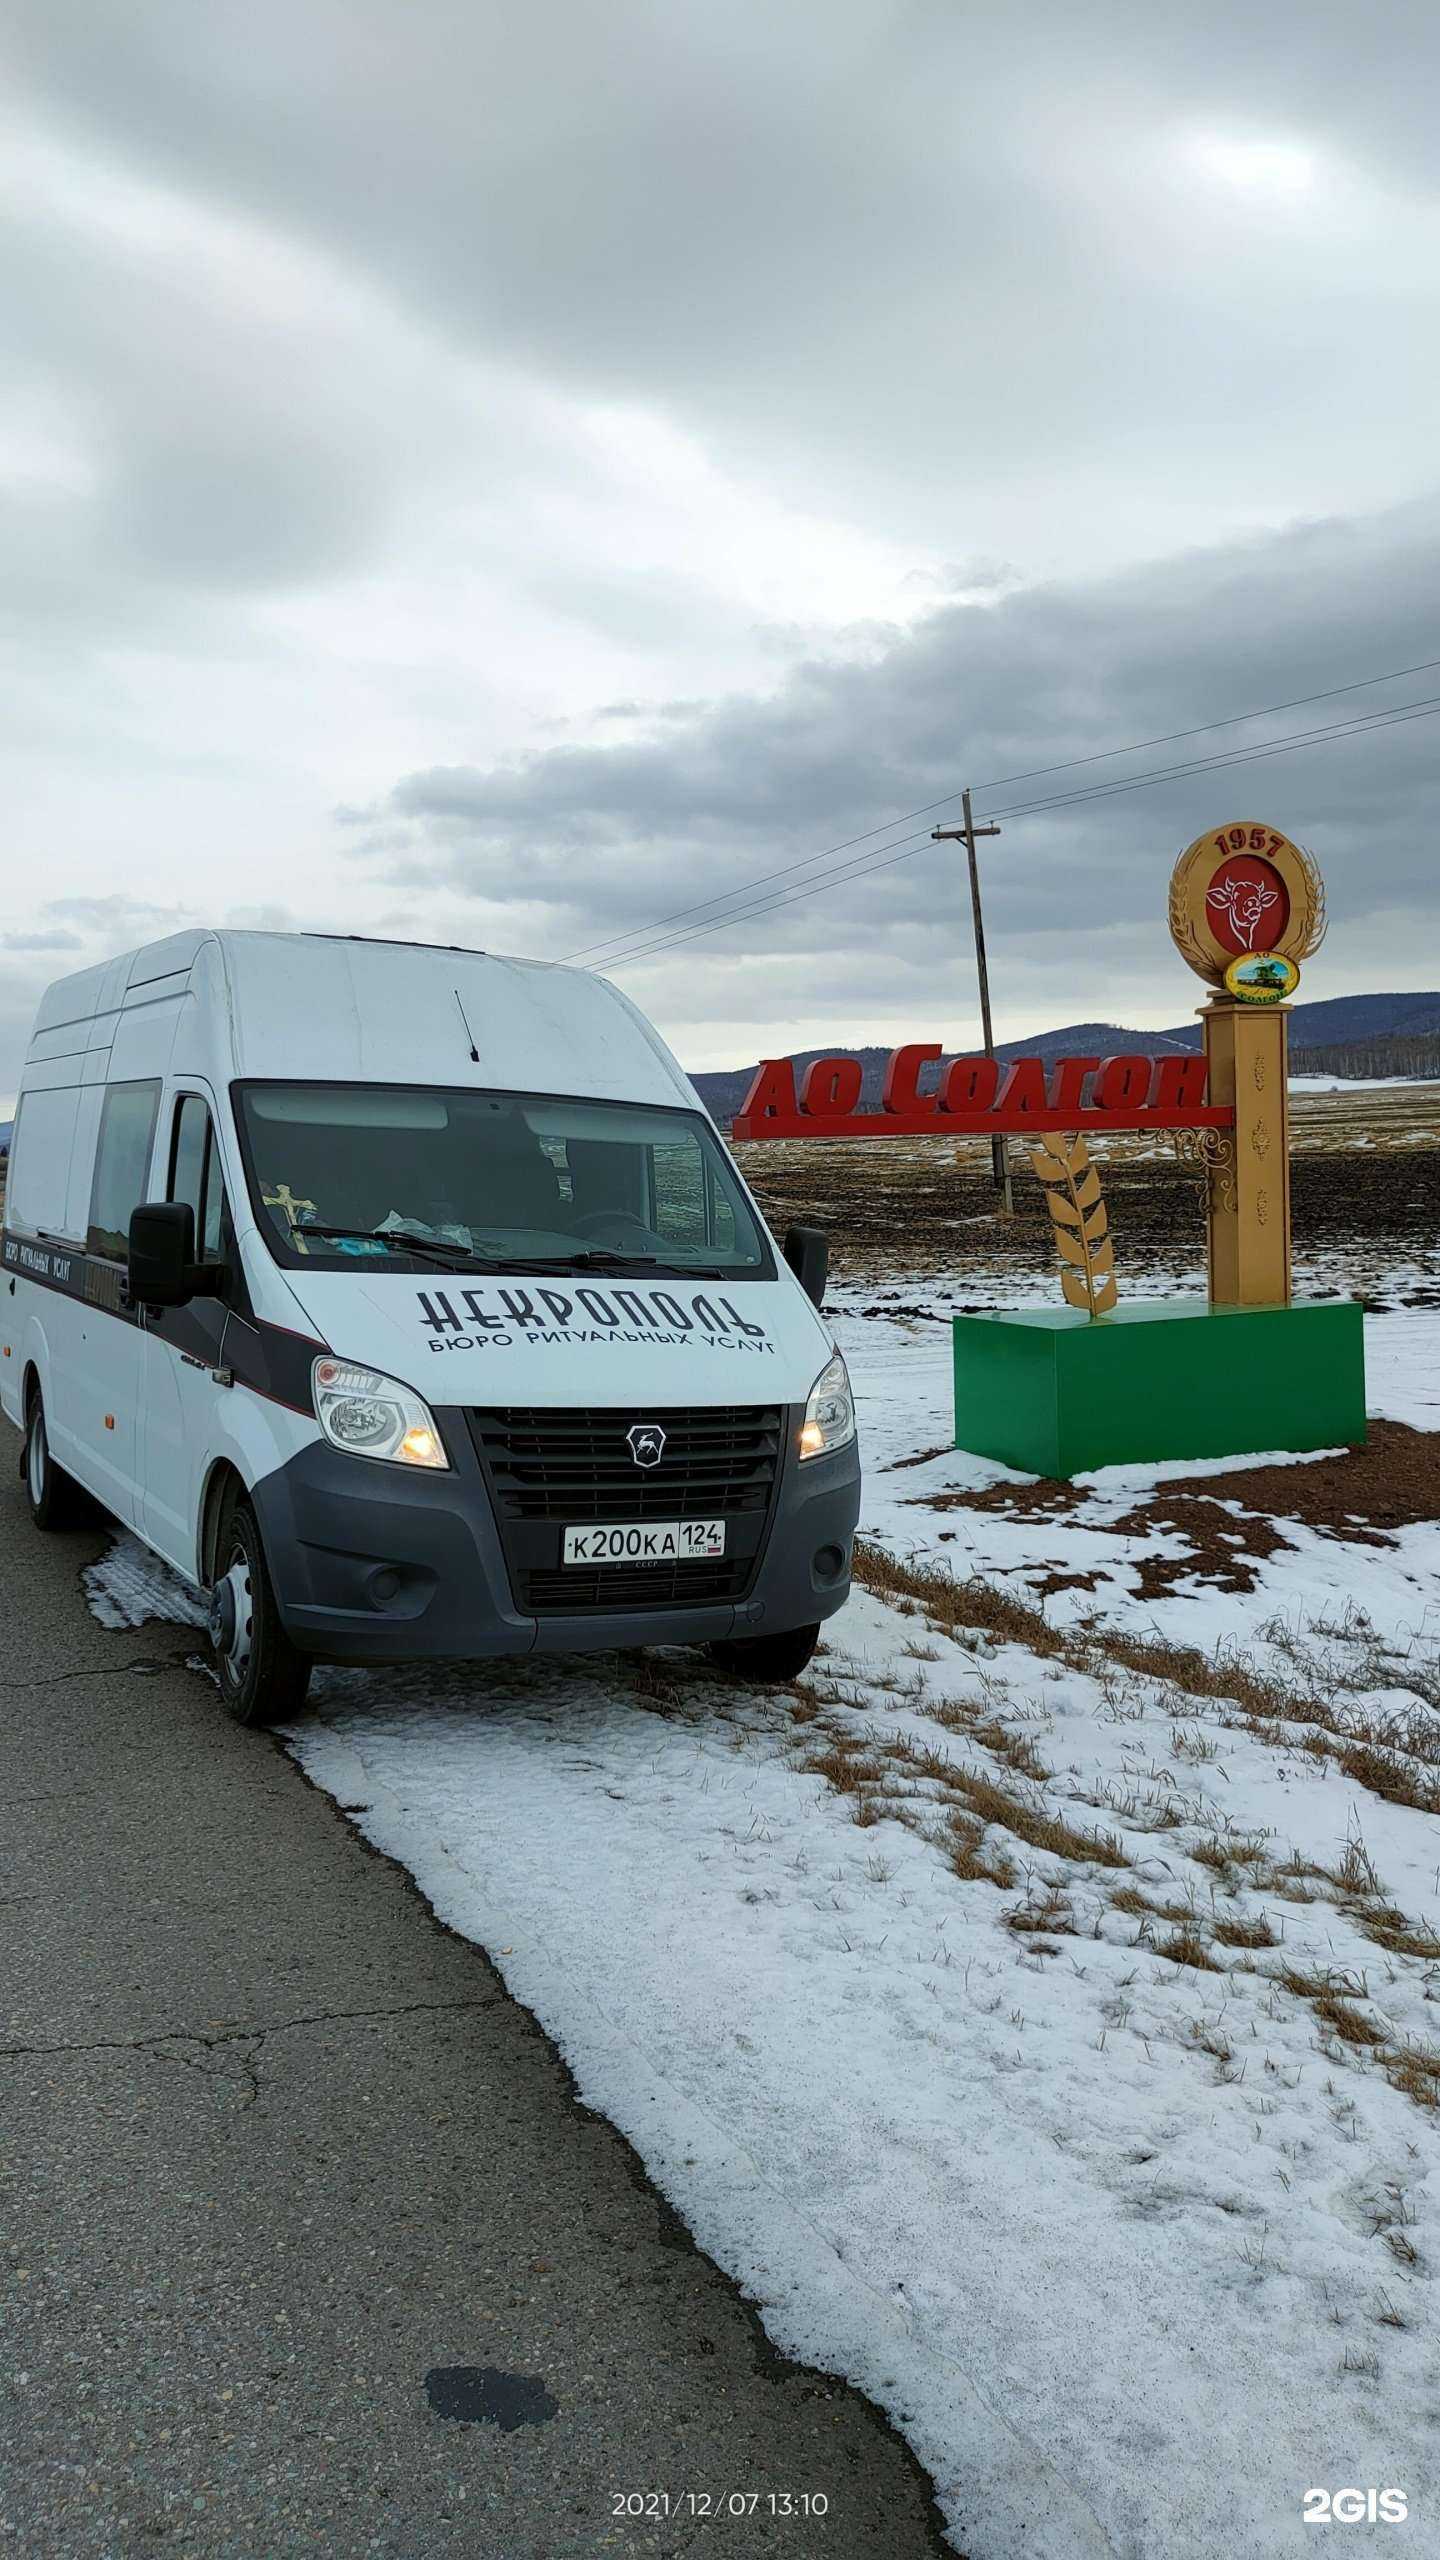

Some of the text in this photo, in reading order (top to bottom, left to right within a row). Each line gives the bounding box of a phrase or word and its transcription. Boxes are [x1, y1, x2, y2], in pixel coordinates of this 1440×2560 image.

[1214, 828, 1285, 857] 1957
[416, 1288, 766, 1337] НЕКРОПОЛЬ
[427, 1330, 776, 1354] БЮРО РИТУАЛЬНЫХ УСЛУГ
[682, 1523, 719, 1546] 124
[688, 1546, 707, 1554] RUS
